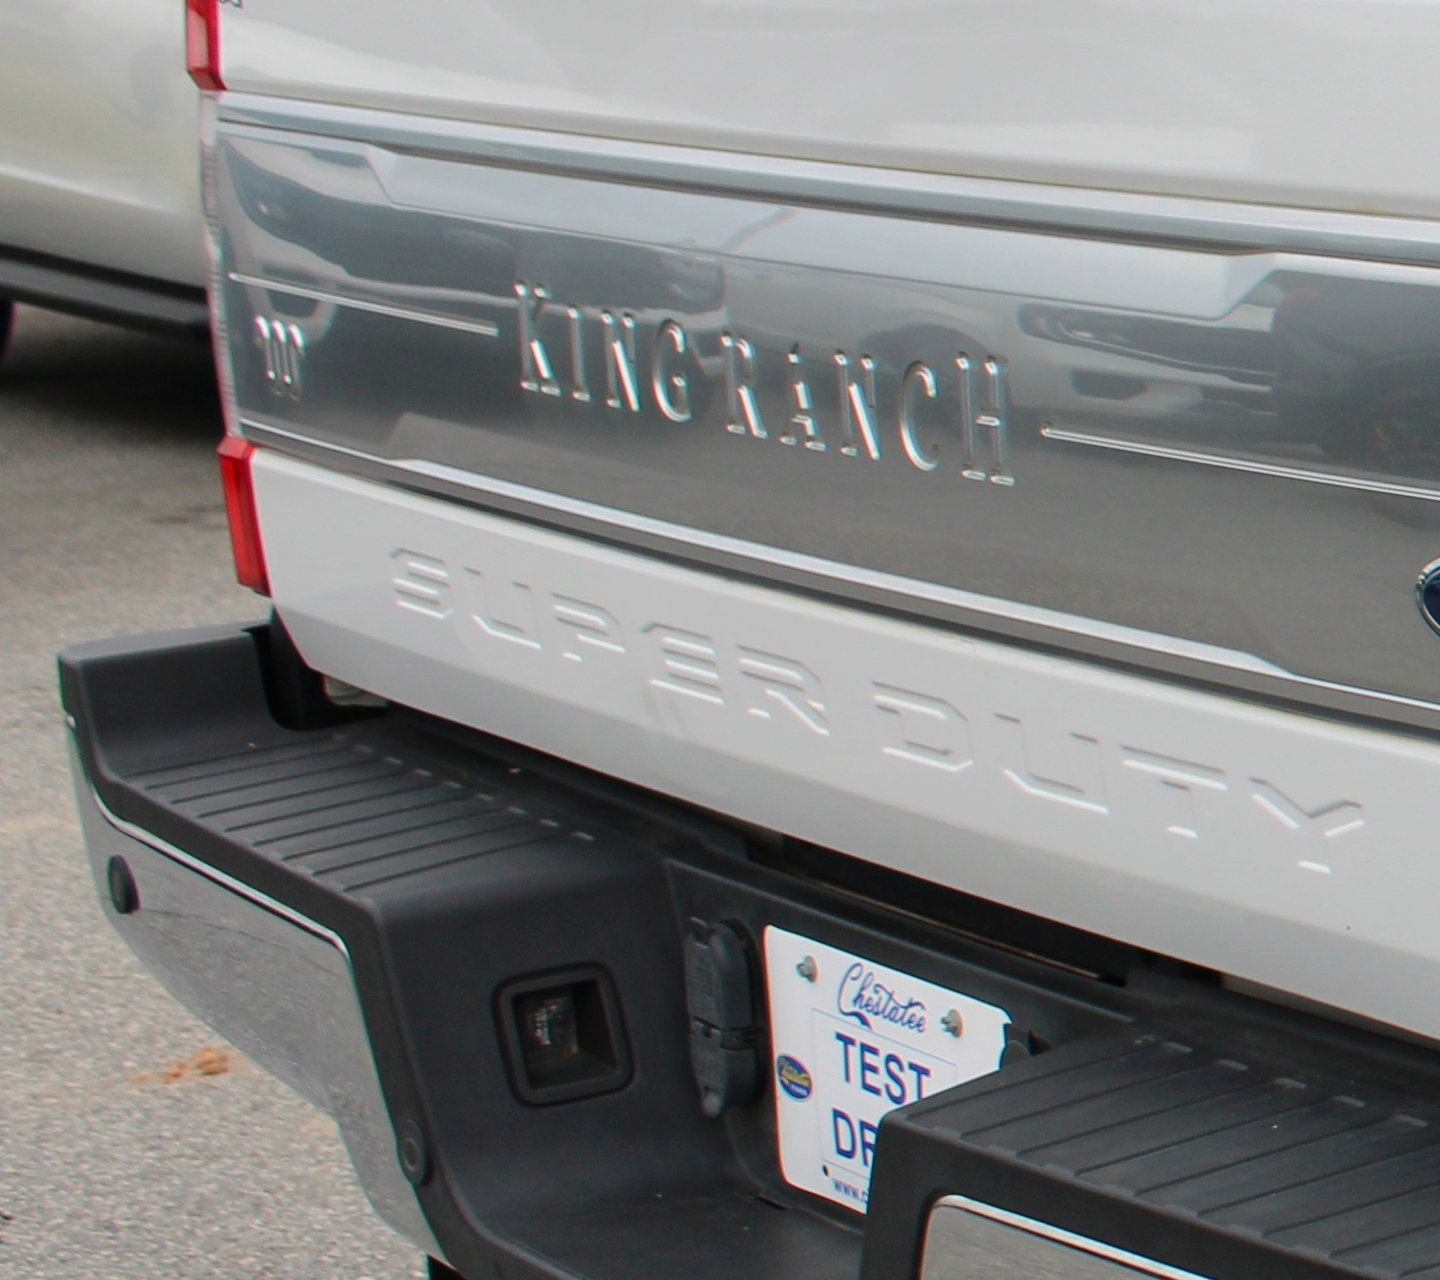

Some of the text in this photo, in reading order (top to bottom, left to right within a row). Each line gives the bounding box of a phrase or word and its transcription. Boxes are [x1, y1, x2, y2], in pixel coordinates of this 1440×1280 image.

[514, 279, 1016, 486] KING RANCH
[391, 547, 1366, 875] SUPER DUTY
[837, 962, 928, 1033] Chestatee
[835, 1031, 932, 1105] TEST
